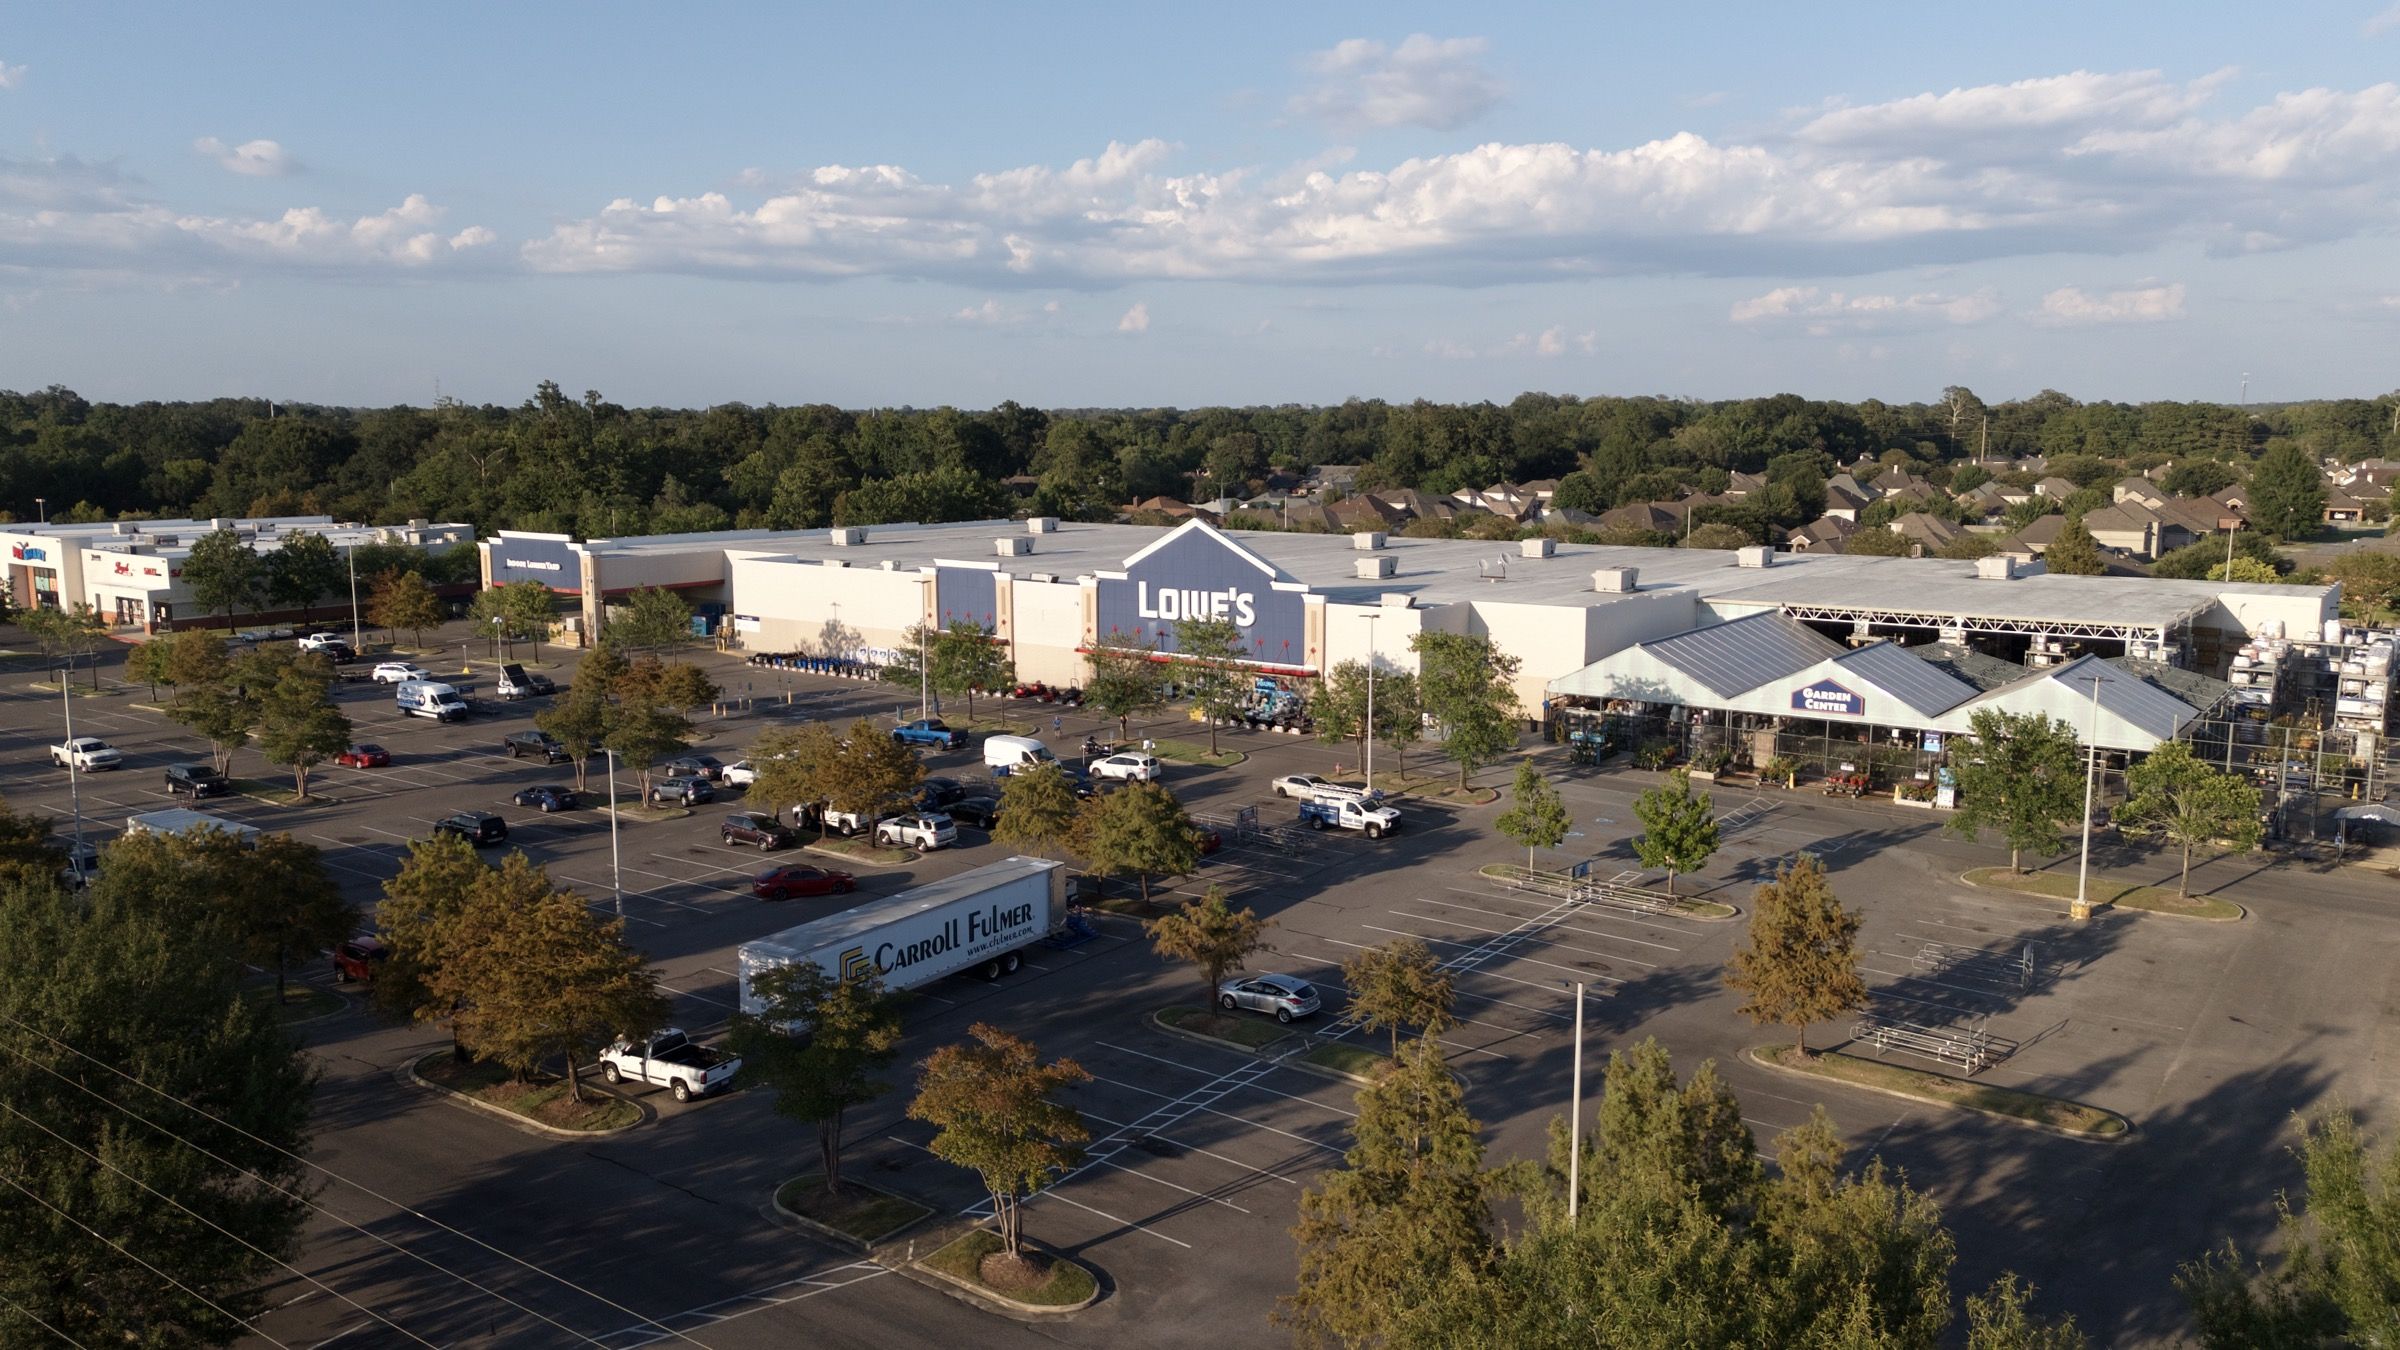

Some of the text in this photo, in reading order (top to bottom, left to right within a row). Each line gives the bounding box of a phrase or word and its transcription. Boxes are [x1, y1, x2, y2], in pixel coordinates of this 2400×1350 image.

[1138, 580, 1257, 627] LOWE'S
[1802, 687, 1852, 703] GARDEN
[1804, 698, 1848, 713] CENTER
